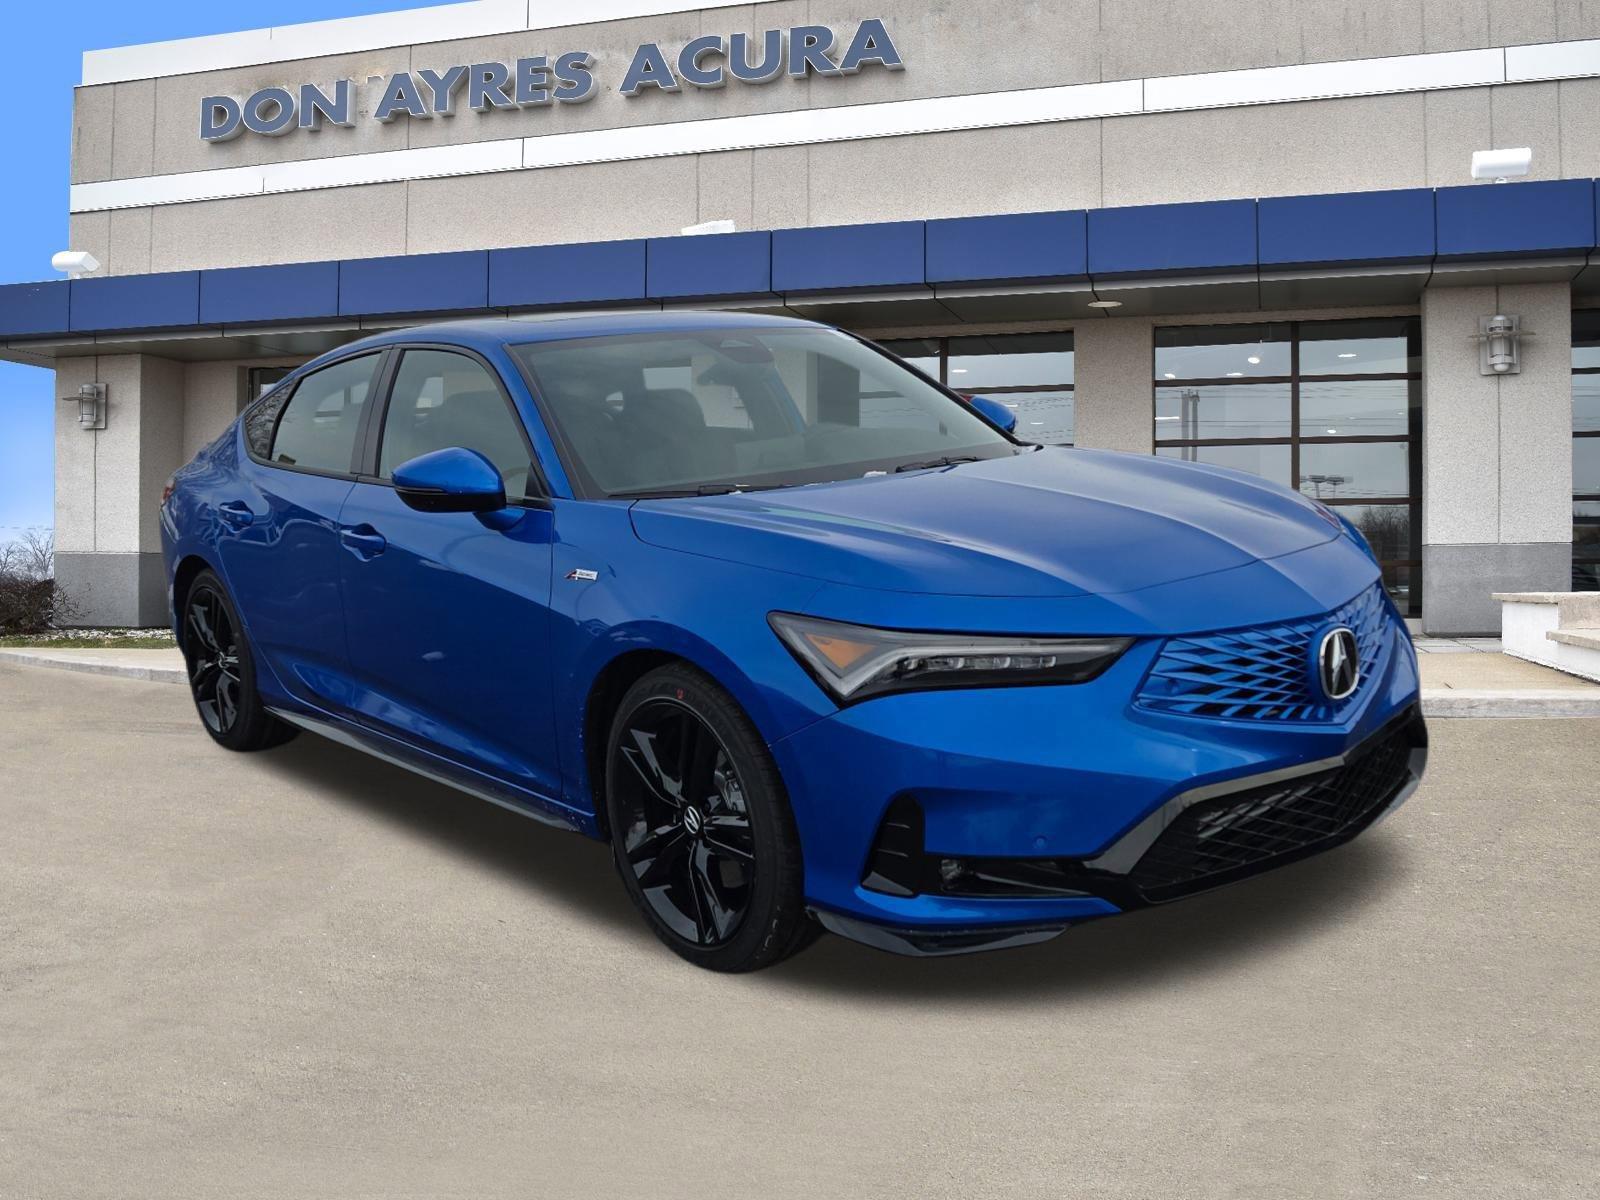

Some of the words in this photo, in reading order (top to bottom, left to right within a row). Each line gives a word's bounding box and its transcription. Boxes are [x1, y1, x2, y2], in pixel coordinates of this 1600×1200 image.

[200, 79, 355, 143] DON
[373, 51, 596, 122] AYRES
[619, 18, 905, 97] ACURA
